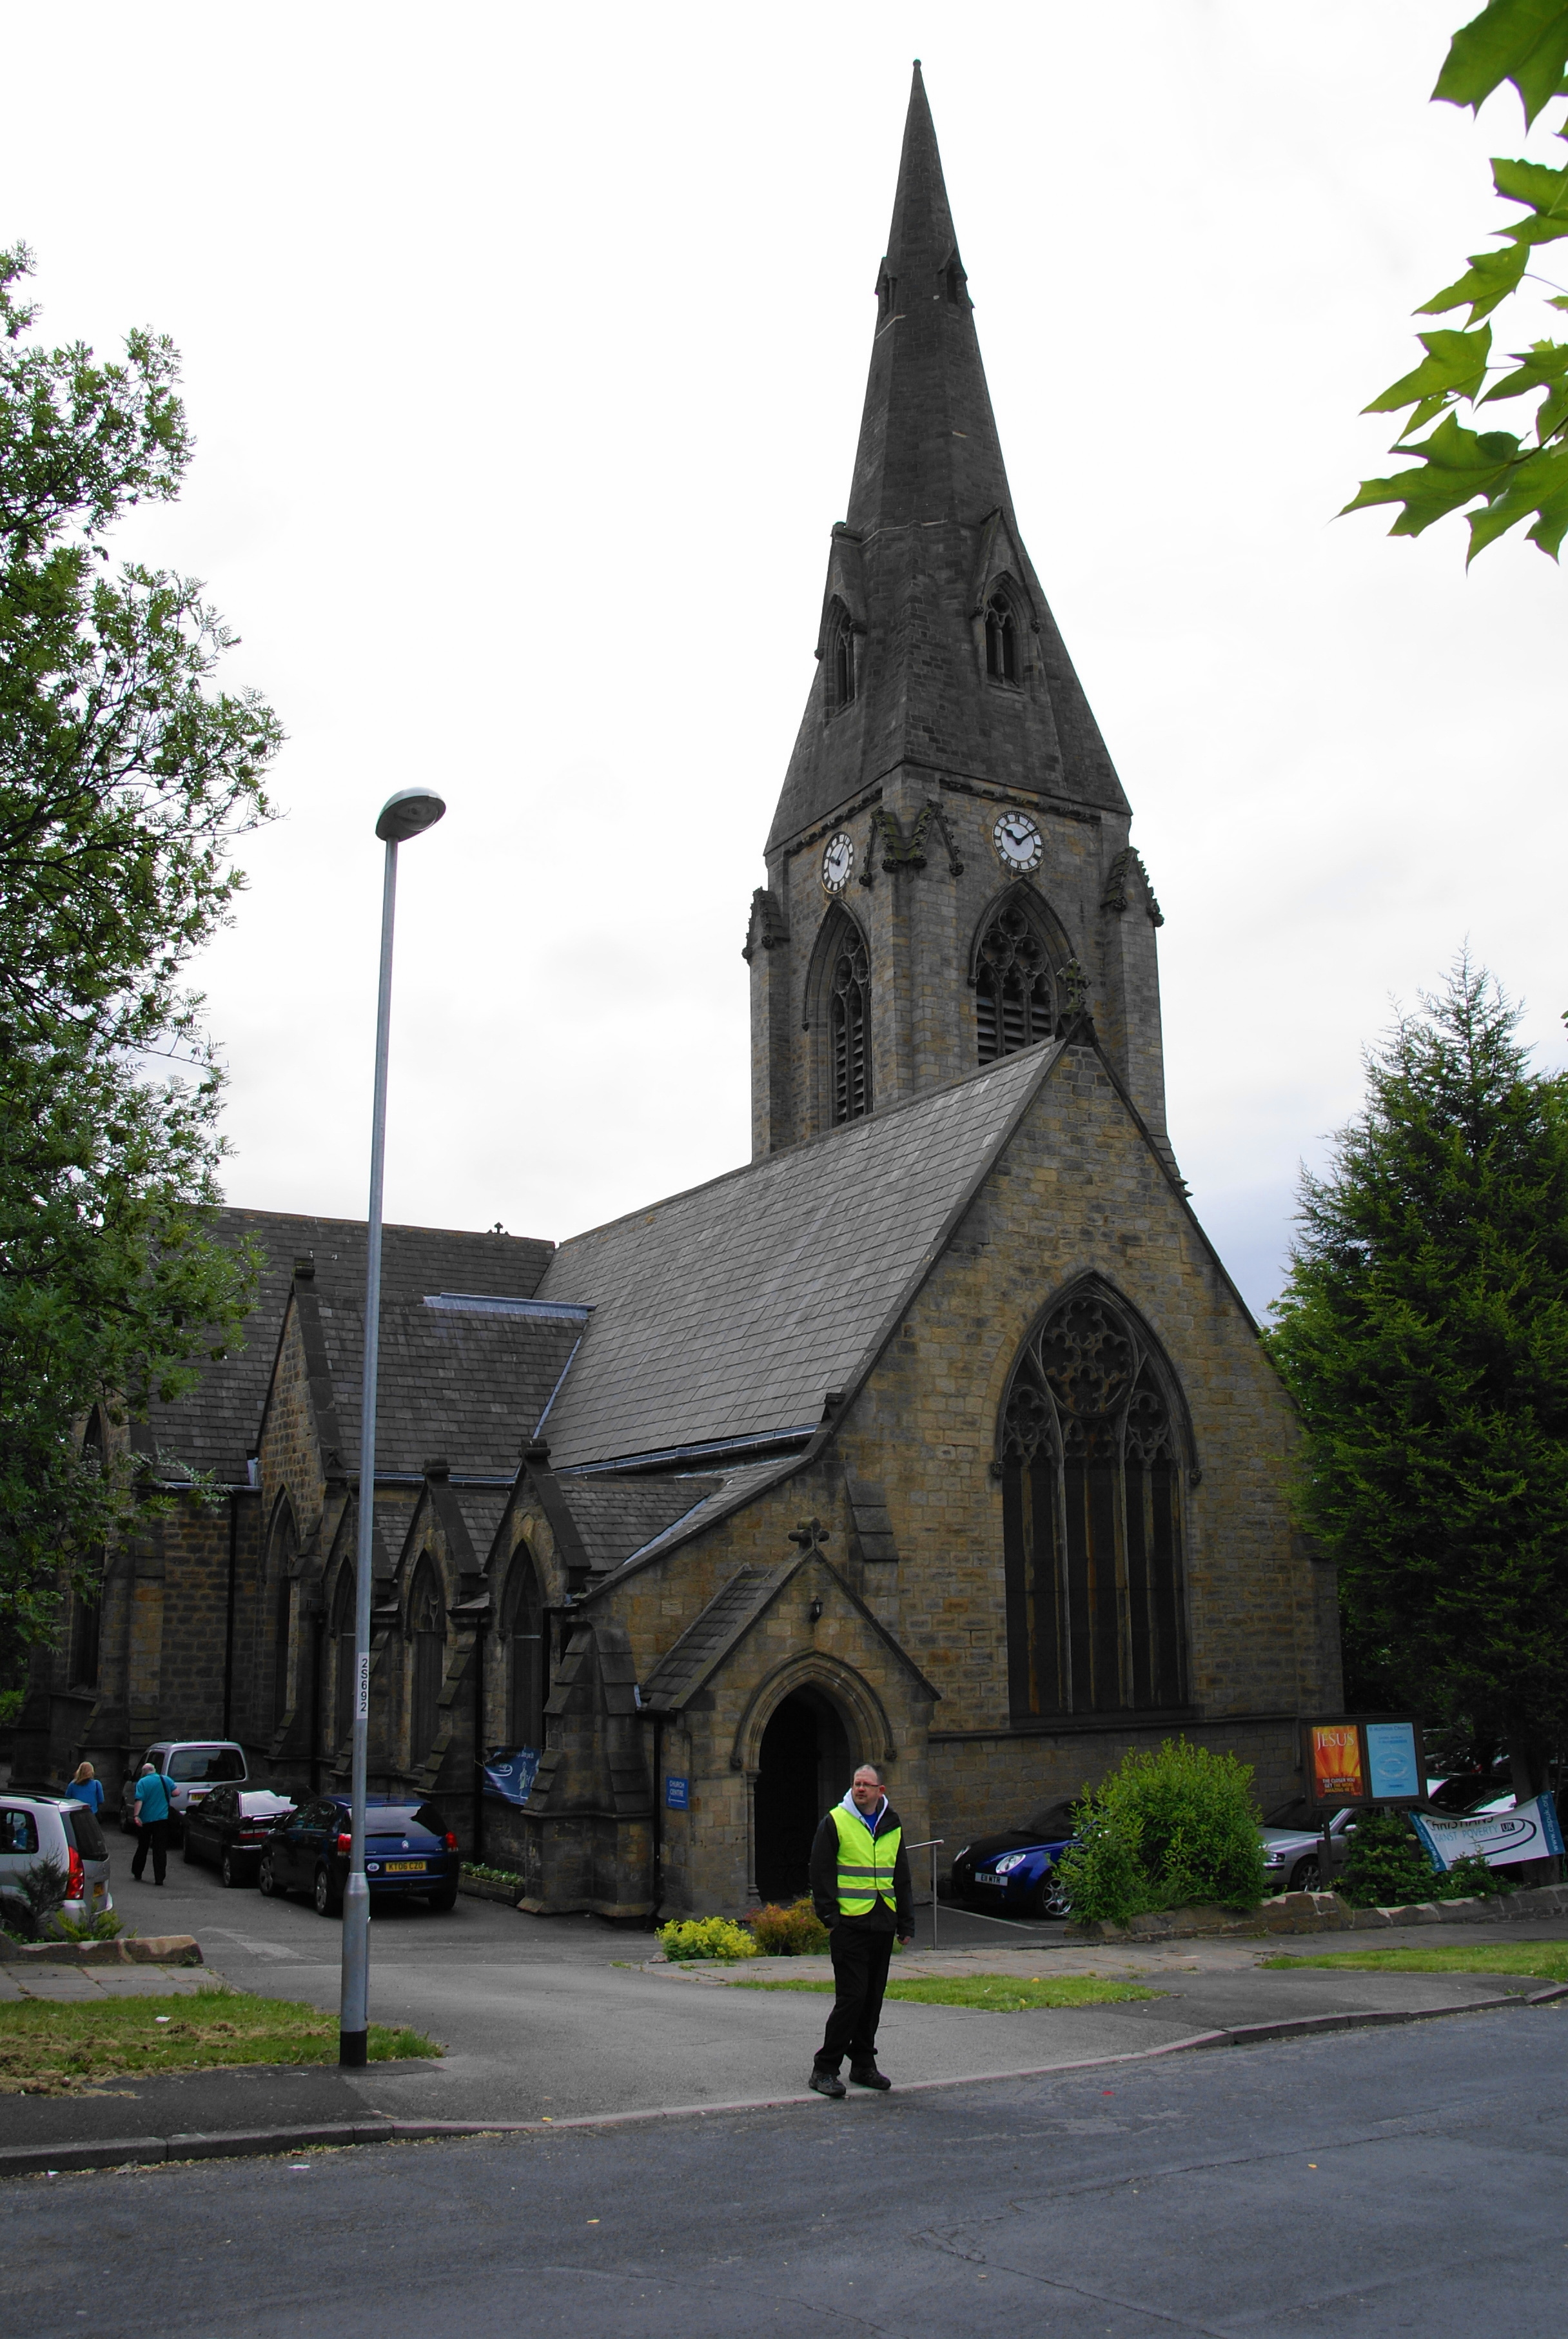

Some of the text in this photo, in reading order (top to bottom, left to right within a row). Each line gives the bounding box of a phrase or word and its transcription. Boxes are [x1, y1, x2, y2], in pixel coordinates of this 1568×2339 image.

[360, 1658, 368, 1712] 2S692
[1317, 1732, 1354, 1751] JESUS
[669, 1780, 685, 1788] CHURCH
[669, 1788, 684, 1797] CENTRE
[1541, 1794, 1558, 1852] www.capuk.org
[1462, 1825, 1498, 1839] POVERTY
